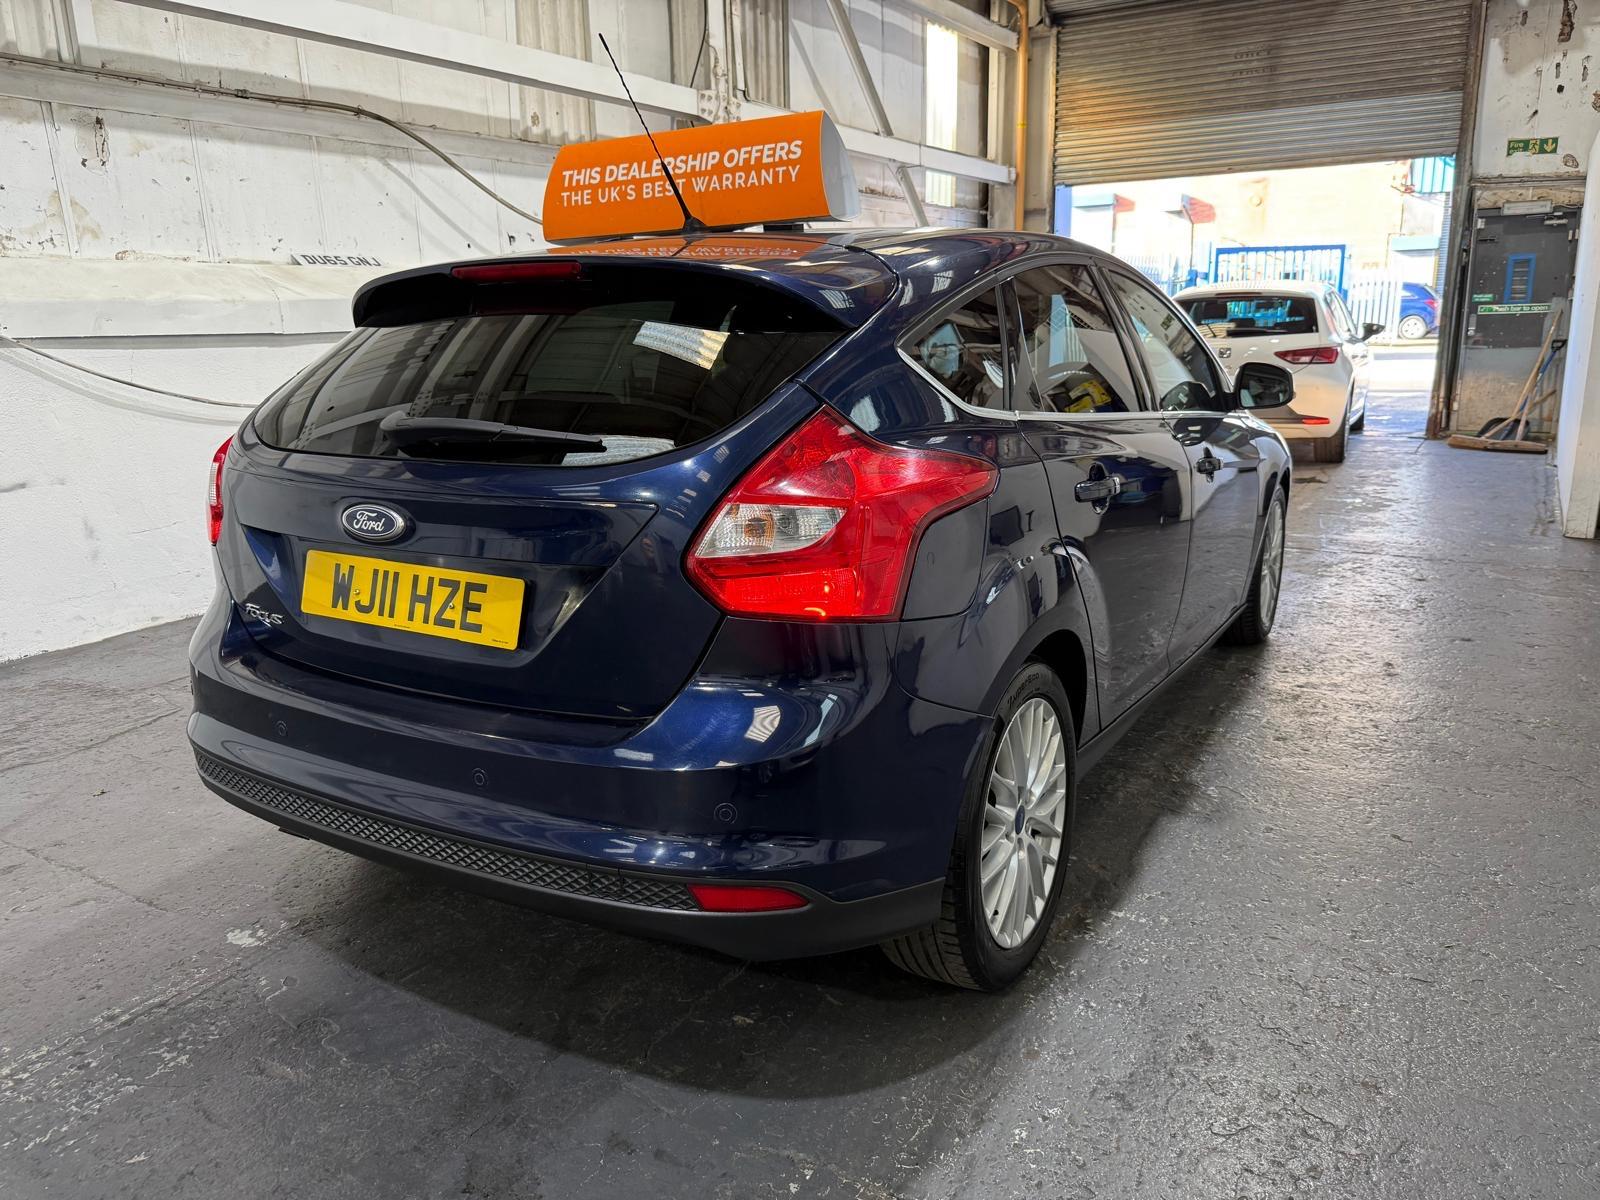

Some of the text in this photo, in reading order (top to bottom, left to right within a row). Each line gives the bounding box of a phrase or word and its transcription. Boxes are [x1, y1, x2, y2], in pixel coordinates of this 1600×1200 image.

[562, 139, 803, 188] THIS DEALERSHIP OFFERS
[561, 164, 800, 207] THE UK'S BEST WARRANTY
[300, 254, 382, 267] DU65 GNJ
[353, 510, 385, 532] Ford
[331, 562, 488, 634] WJ11 HZE
